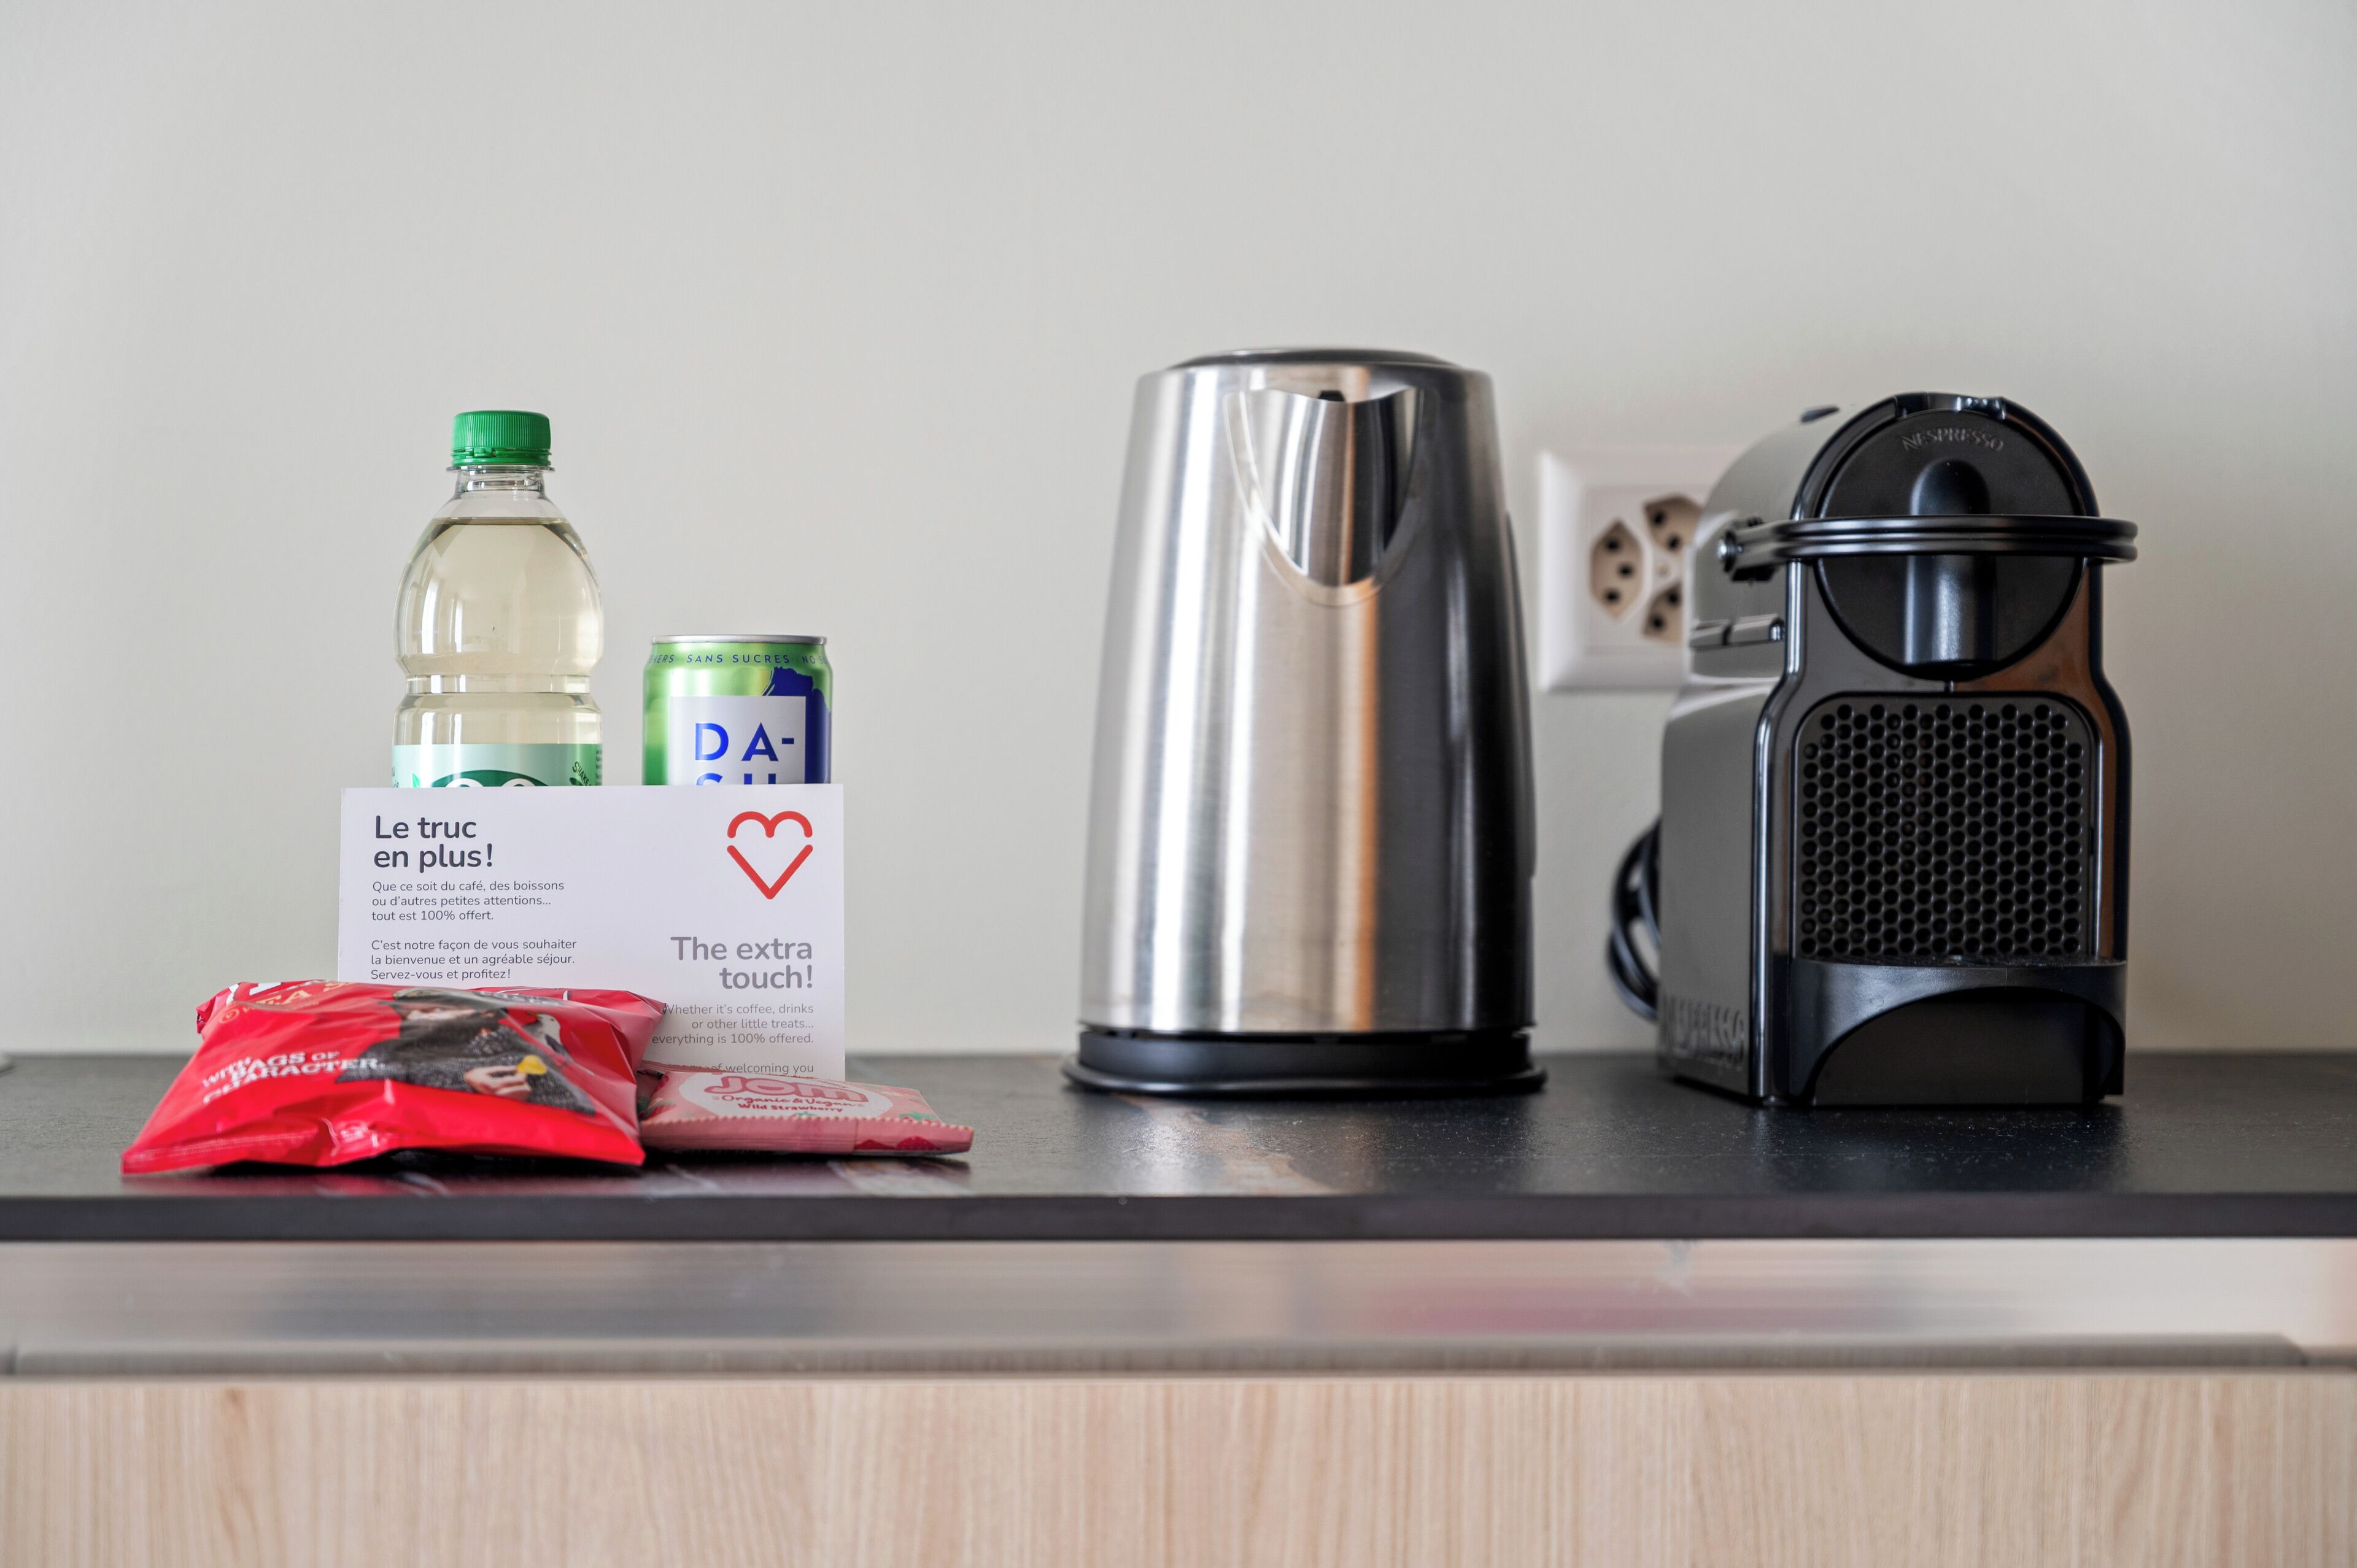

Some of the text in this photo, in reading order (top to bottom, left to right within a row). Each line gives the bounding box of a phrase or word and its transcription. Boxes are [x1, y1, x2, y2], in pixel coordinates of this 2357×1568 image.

[1900, 427, 2003, 452] NESPRESSO
[686, 654, 723, 663] SANS
[732, 654, 791, 663] SUCRES
[695, 722, 795, 762] DA-
[375, 815, 477, 840] Le truc
[373, 843, 493, 874] en plus!
[373, 881, 397, 893] Que
[416, 881, 437, 891] soit
[440, 881, 455, 892] du
[459, 879, 486, 892] café,
[489, 880, 510, 890] des
[514, 880, 565, 890] boissons
[390, 895, 437, 906] d'autres
[441, 895, 481, 908] petites
[484, 895, 551, 905] attentions...
[371, 910, 493, 921] tout est 100% offert.
[371, 940, 401, 950] C'est
[404, 941, 435, 950] notre
[438, 940, 470, 952] façon
[473, 940, 488, 949] de
[522, 938, 577, 949] souhaiter
[670, 937, 813, 961] The extra
[371, 955, 381, 965] la
[385, 955, 446, 965] bienvenue
[449, 956, 461, 965] et
[482, 954, 533, 966] agréable
[536, 953, 575, 966] séjour.
[371, 968, 511, 981] Servez-vous et profitez!
[719, 964, 814, 990] touch!
[663, 1003, 814, 1014] Whether it's coffee, drinks
[707, 1019, 738, 1029] other
[741, 1019, 768, 1029] little
[771, 1019, 814, 1029] treats...
[652, 1033, 814, 1046] everything is 100% offered.
[231, 1051, 340, 1083] BAGS OF
[726, 1063, 789, 1075] welcoming
[792, 1065, 814, 1075] you
[722, 1095, 791, 1103] Organic
